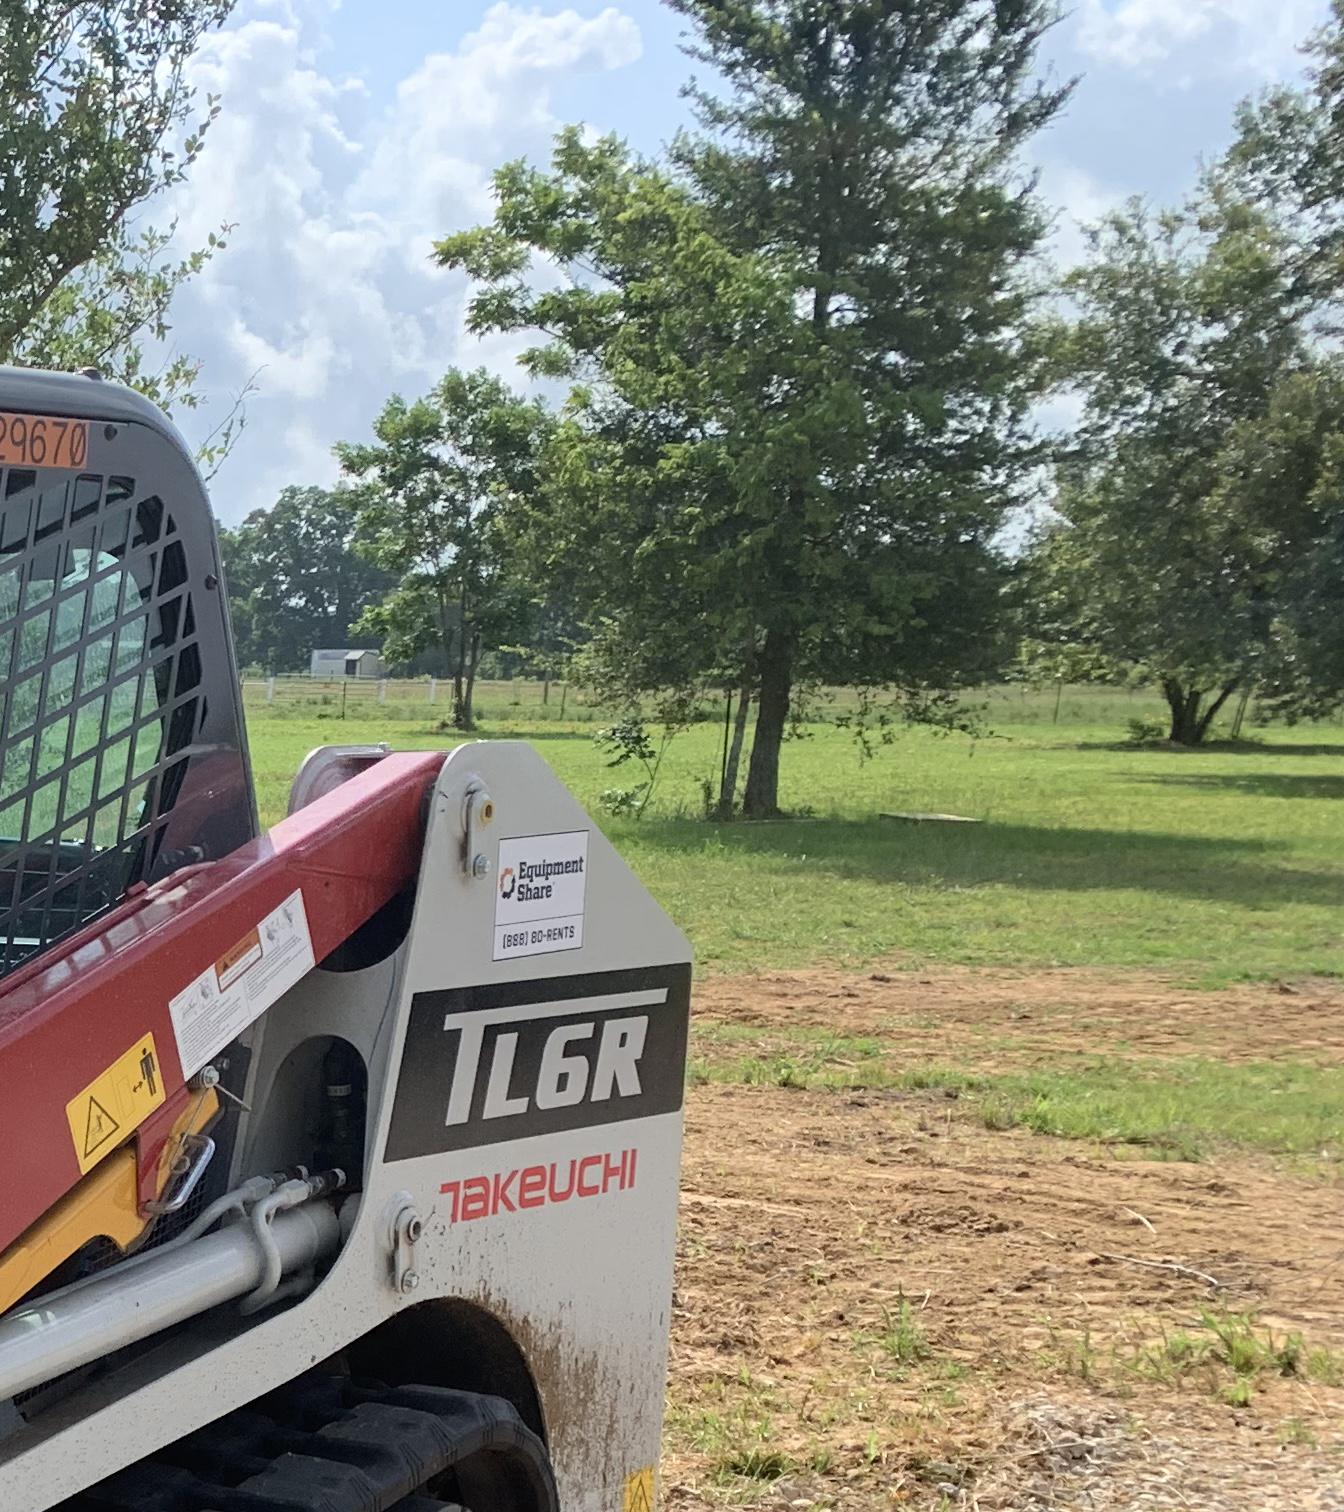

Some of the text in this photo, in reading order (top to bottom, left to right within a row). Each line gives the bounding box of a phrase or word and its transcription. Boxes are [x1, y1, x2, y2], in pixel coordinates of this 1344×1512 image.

[518, 856, 584, 882] Equipment
[517, 884, 553, 901] Share
[531, 925, 575, 944] 80-RENTS
[443, 988, 669, 1126] TL6R
[439, 1148, 637, 1223] TAKEUCHI
